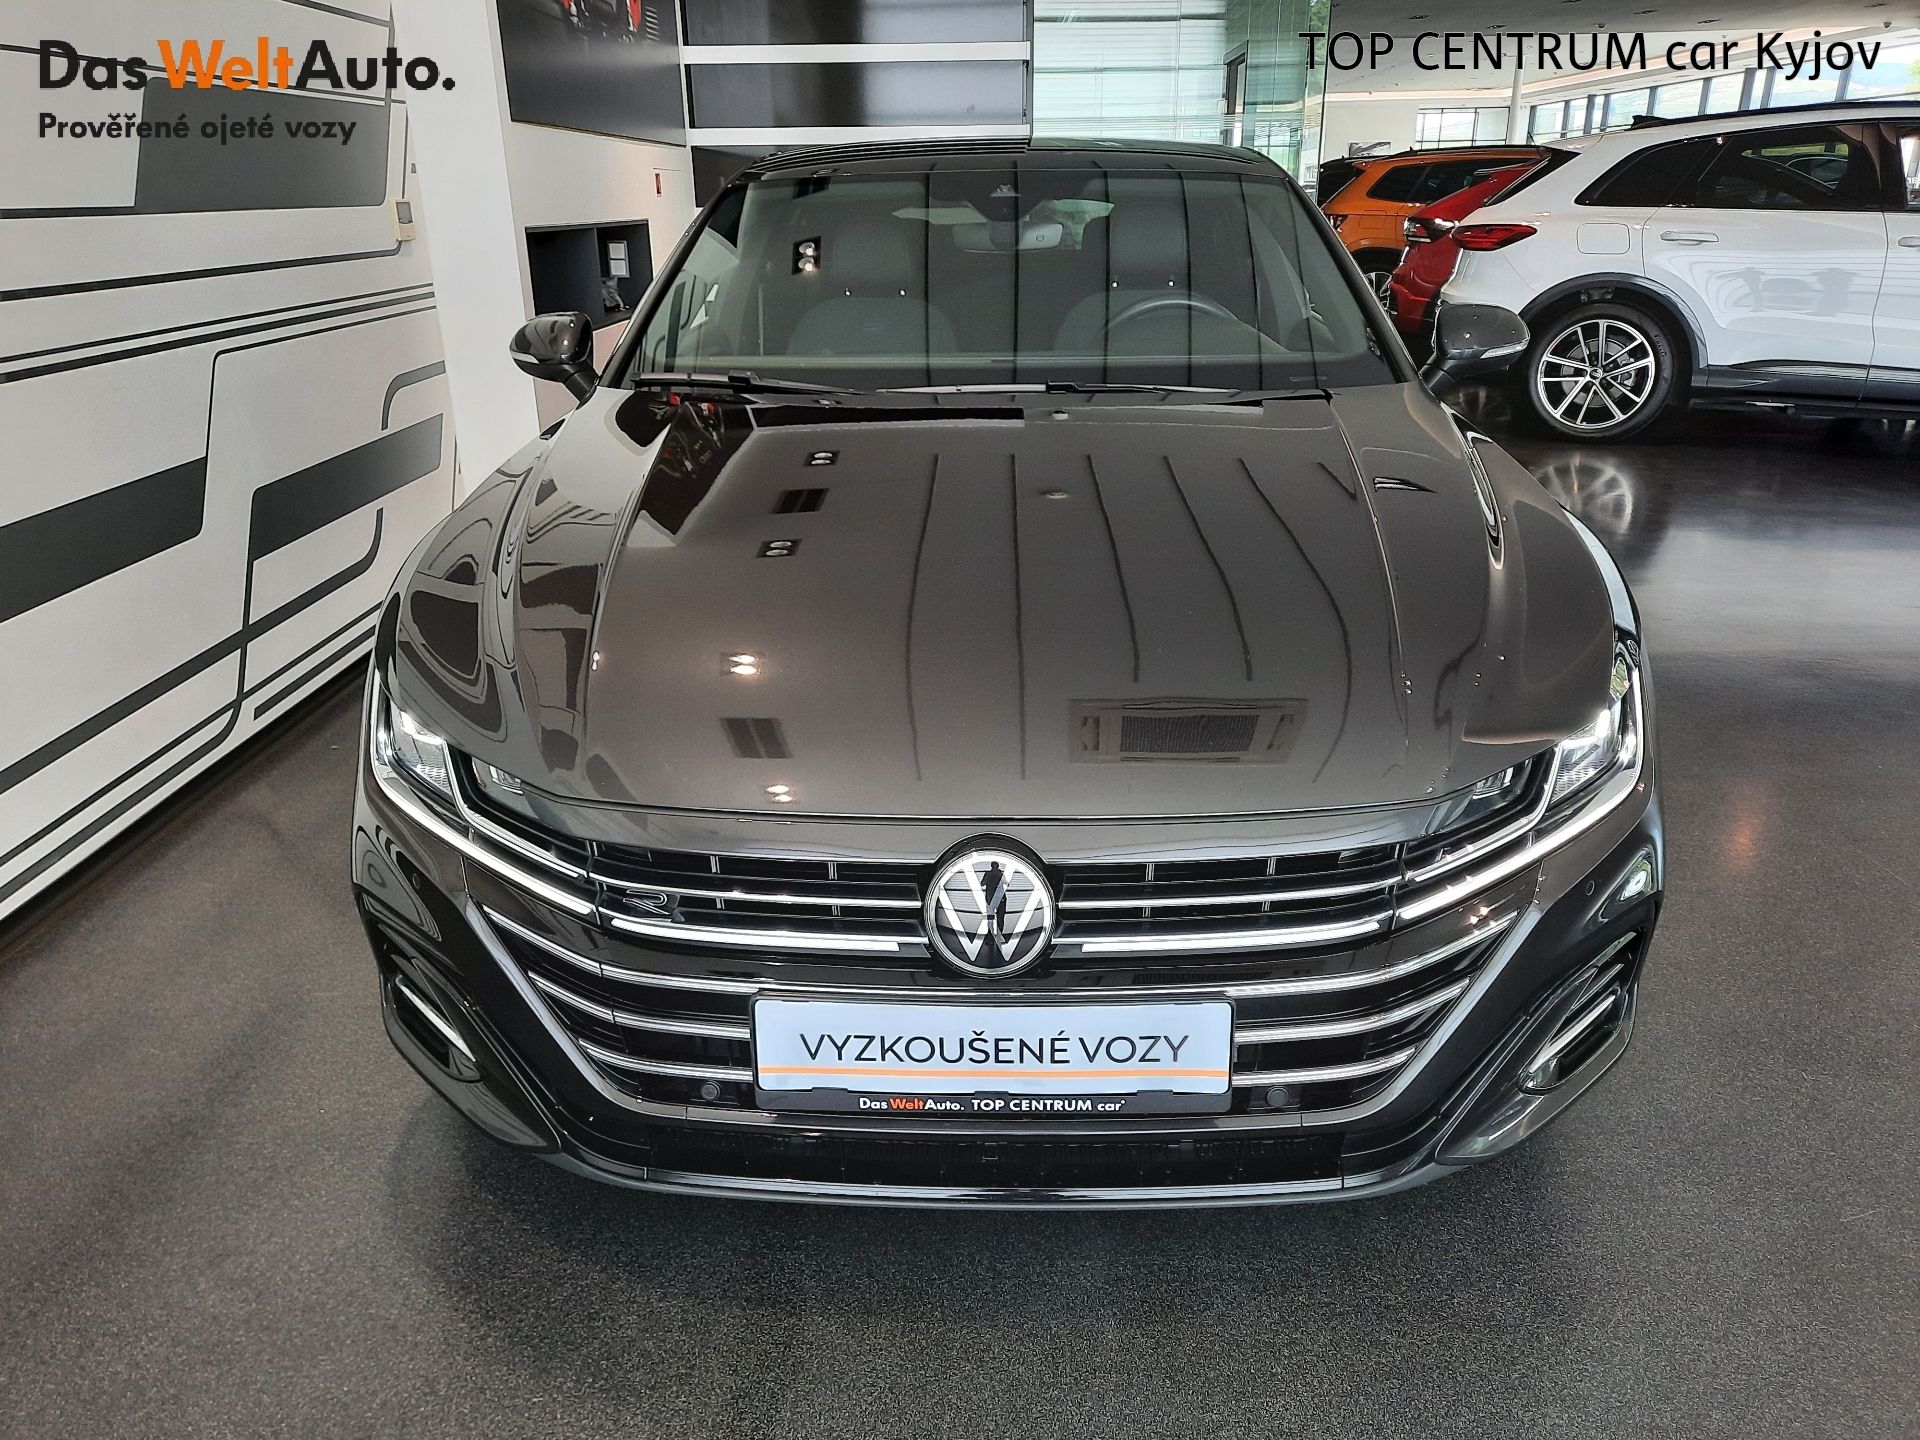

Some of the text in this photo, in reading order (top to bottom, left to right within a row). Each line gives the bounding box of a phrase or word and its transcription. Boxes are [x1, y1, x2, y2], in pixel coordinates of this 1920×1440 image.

[799, 1030, 1190, 1065] VYZKOUŠENÉ VOZY
[859, 1097, 888, 1110] Das
[971, 1099, 1005, 1111] TOP
[1009, 1099, 1093, 1112] CENTRUM
